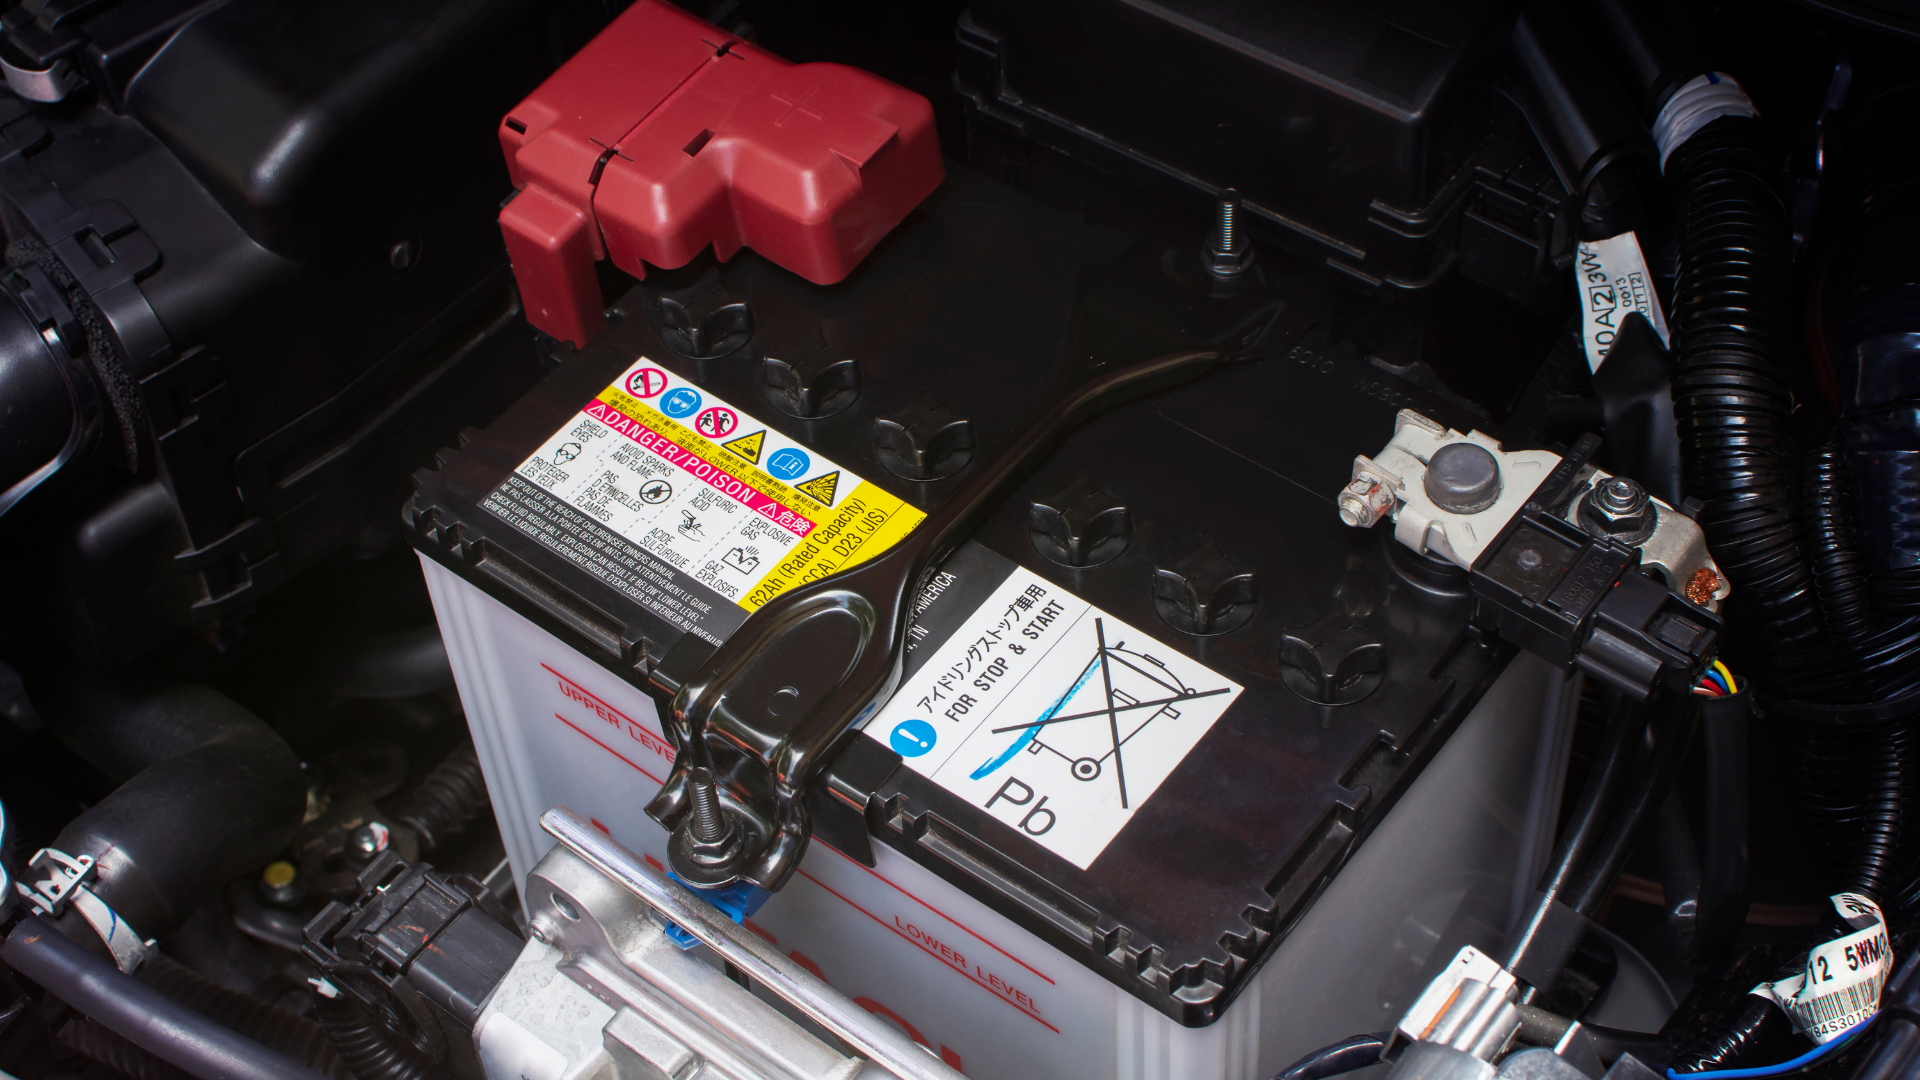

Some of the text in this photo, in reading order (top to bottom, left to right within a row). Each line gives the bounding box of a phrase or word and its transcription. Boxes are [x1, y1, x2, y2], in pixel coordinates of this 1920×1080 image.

[570, 426, 592, 442] EYES
[579, 419, 608, 438] SHIELD
[529, 456, 569, 482] PROTEGER
[603, 411, 755, 502] DANGER/POISON
[609, 450, 655, 479] AND FLAME
[618, 442, 674, 477] AVOID SPARKS
[520, 464, 557, 490] LES YEUX.
[600, 469, 619, 483] PAS
[573, 495, 613, 521] FLAMMES
[582, 486, 612, 507] PAS DE
[688, 496, 710, 511] ACID
[698, 487, 737, 513] SULFURIC
[490, 491, 512, 506] CHECK
[508, 502, 528, 516] FLUID
[525, 512, 561, 538] REGULARLY.
[560, 534, 596, 557] EXPLOSION
[592, 553, 608, 565] CAN
[605, 560, 631, 578] RESULT
[507, 476, 525, 488] KEEP
[522, 484, 538, 496] OUT
[534, 492, 546, 500] OF
[542, 496, 557, 508] THE
[553, 503, 576, 519] REACH
[573, 515, 585, 524] OF
[622, 544, 650, 564] OWNERS
[647, 560, 675, 580] MANUAL
[648, 527, 675, 545] ACIDE
[740, 525, 759, 540] GAS
[748, 516, 793, 546] EXPLOSIVE
[774, 510, 810, 535] 危険
[832, 532, 862, 557] D23
[855, 507, 888, 534] (JIS)
[483, 498, 509, 517] VERIFIER
[506, 513, 518, 522] LE
[514, 518, 541, 536] LIQUIDE
[606, 574, 645, 600] D'EXPLOSER
[642, 596, 652, 604] SI
[649, 600, 683, 624] INFERIEUR
[680, 620, 693, 629] AU
[499, 483, 511, 492] NE
[508, 488, 522, 499] PAS
[519, 495, 546, 513] LAISSER
[548, 512, 559, 522] LA
[556, 517, 582, 535] PORTEE
[578, 530, 594, 542] DES
[634, 564, 684, 596] ATTENTIVEMENT
[681, 592, 692, 602] LE
[689, 597, 711, 614] GUIDE.
[639, 535, 689, 568] SULFURIQUE
[749, 497, 866, 608] 62Ah (Rated Capacity)
[704, 560, 724, 575] GAZ
[694, 568, 738, 599] EXPLOSIFS.
[916, 571, 956, 613] AMERICA
[917, 584, 1046, 712] アイドリングストップ車用
[944, 599, 1064, 722] FOR STOP & START
[558, 681, 620, 729] UPPER
[984, 776, 1055, 835] Pb
[895, 915, 1040, 1014] LOWER LEVEL
